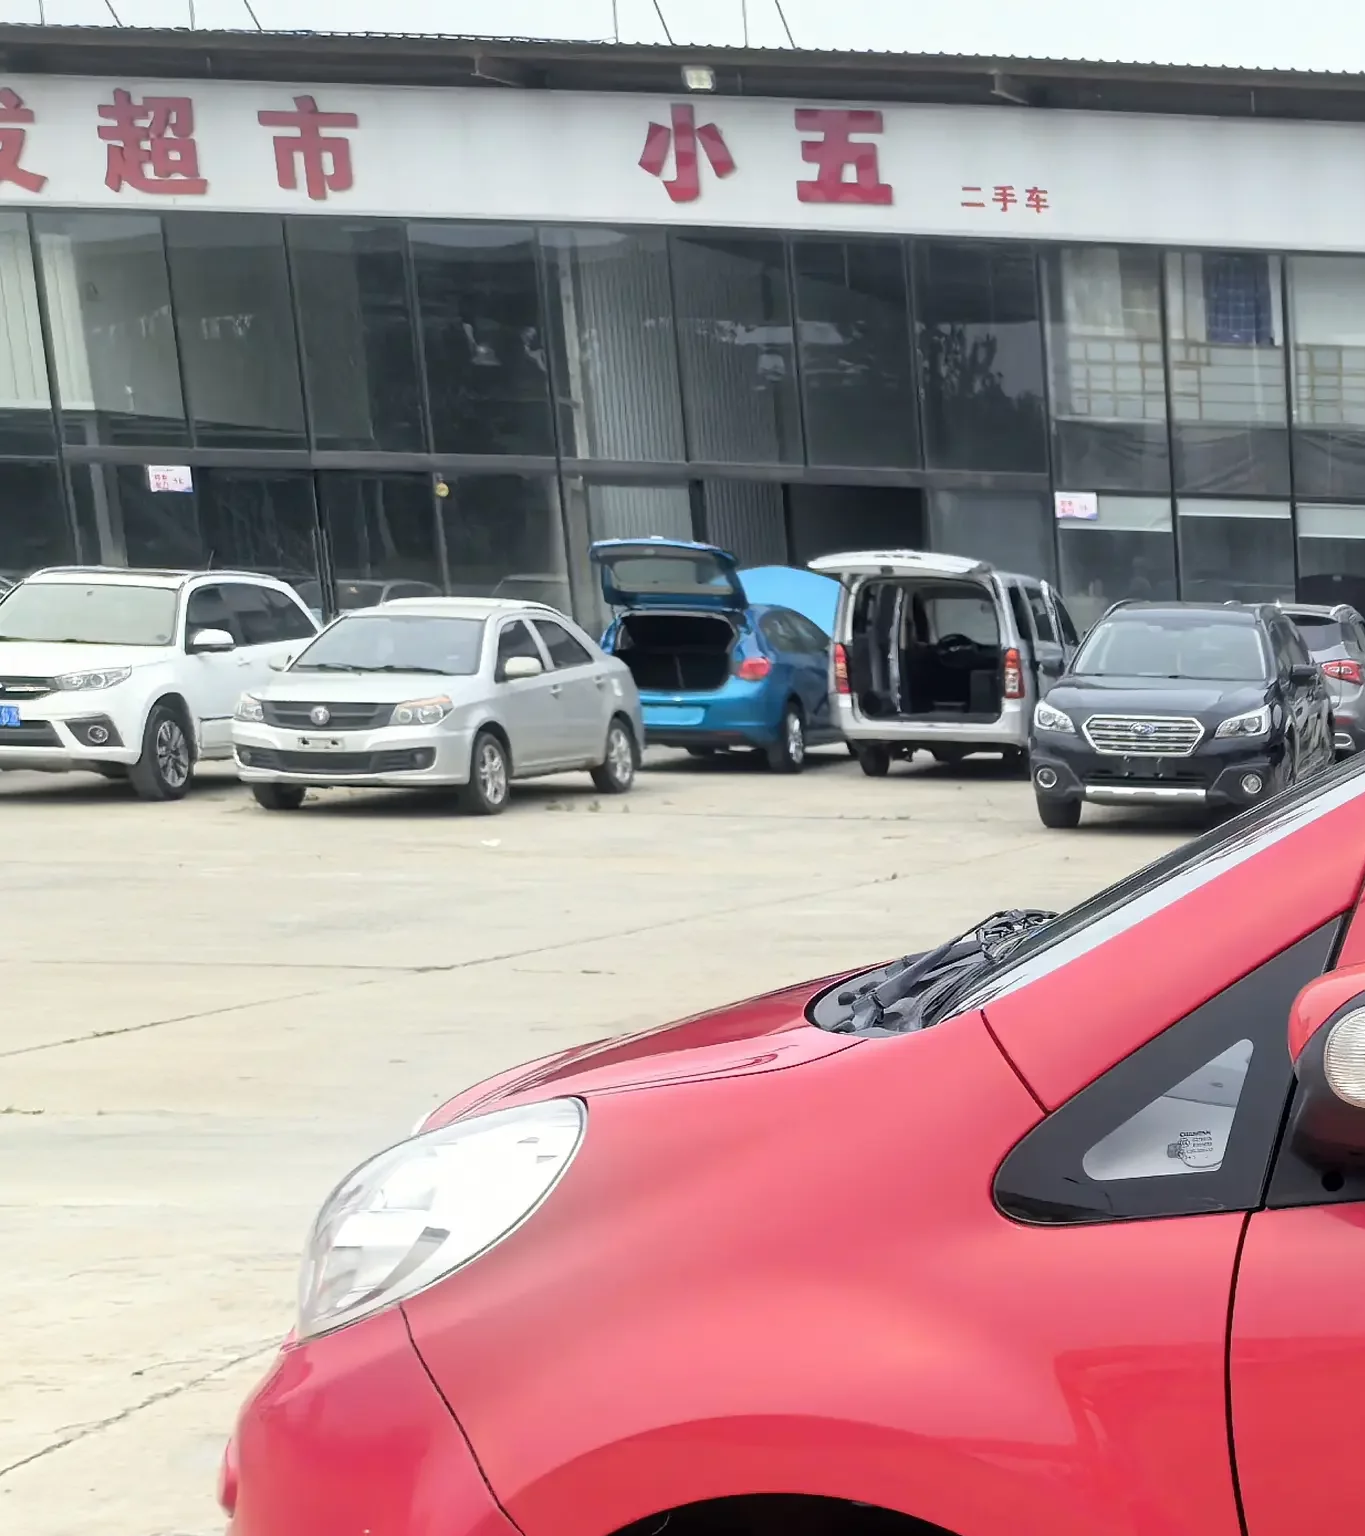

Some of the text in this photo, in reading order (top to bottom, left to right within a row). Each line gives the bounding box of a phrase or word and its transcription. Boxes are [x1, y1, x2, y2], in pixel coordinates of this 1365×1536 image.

[638, 102, 894, 206] 小五
[960, 185, 1050, 214] 二手车
